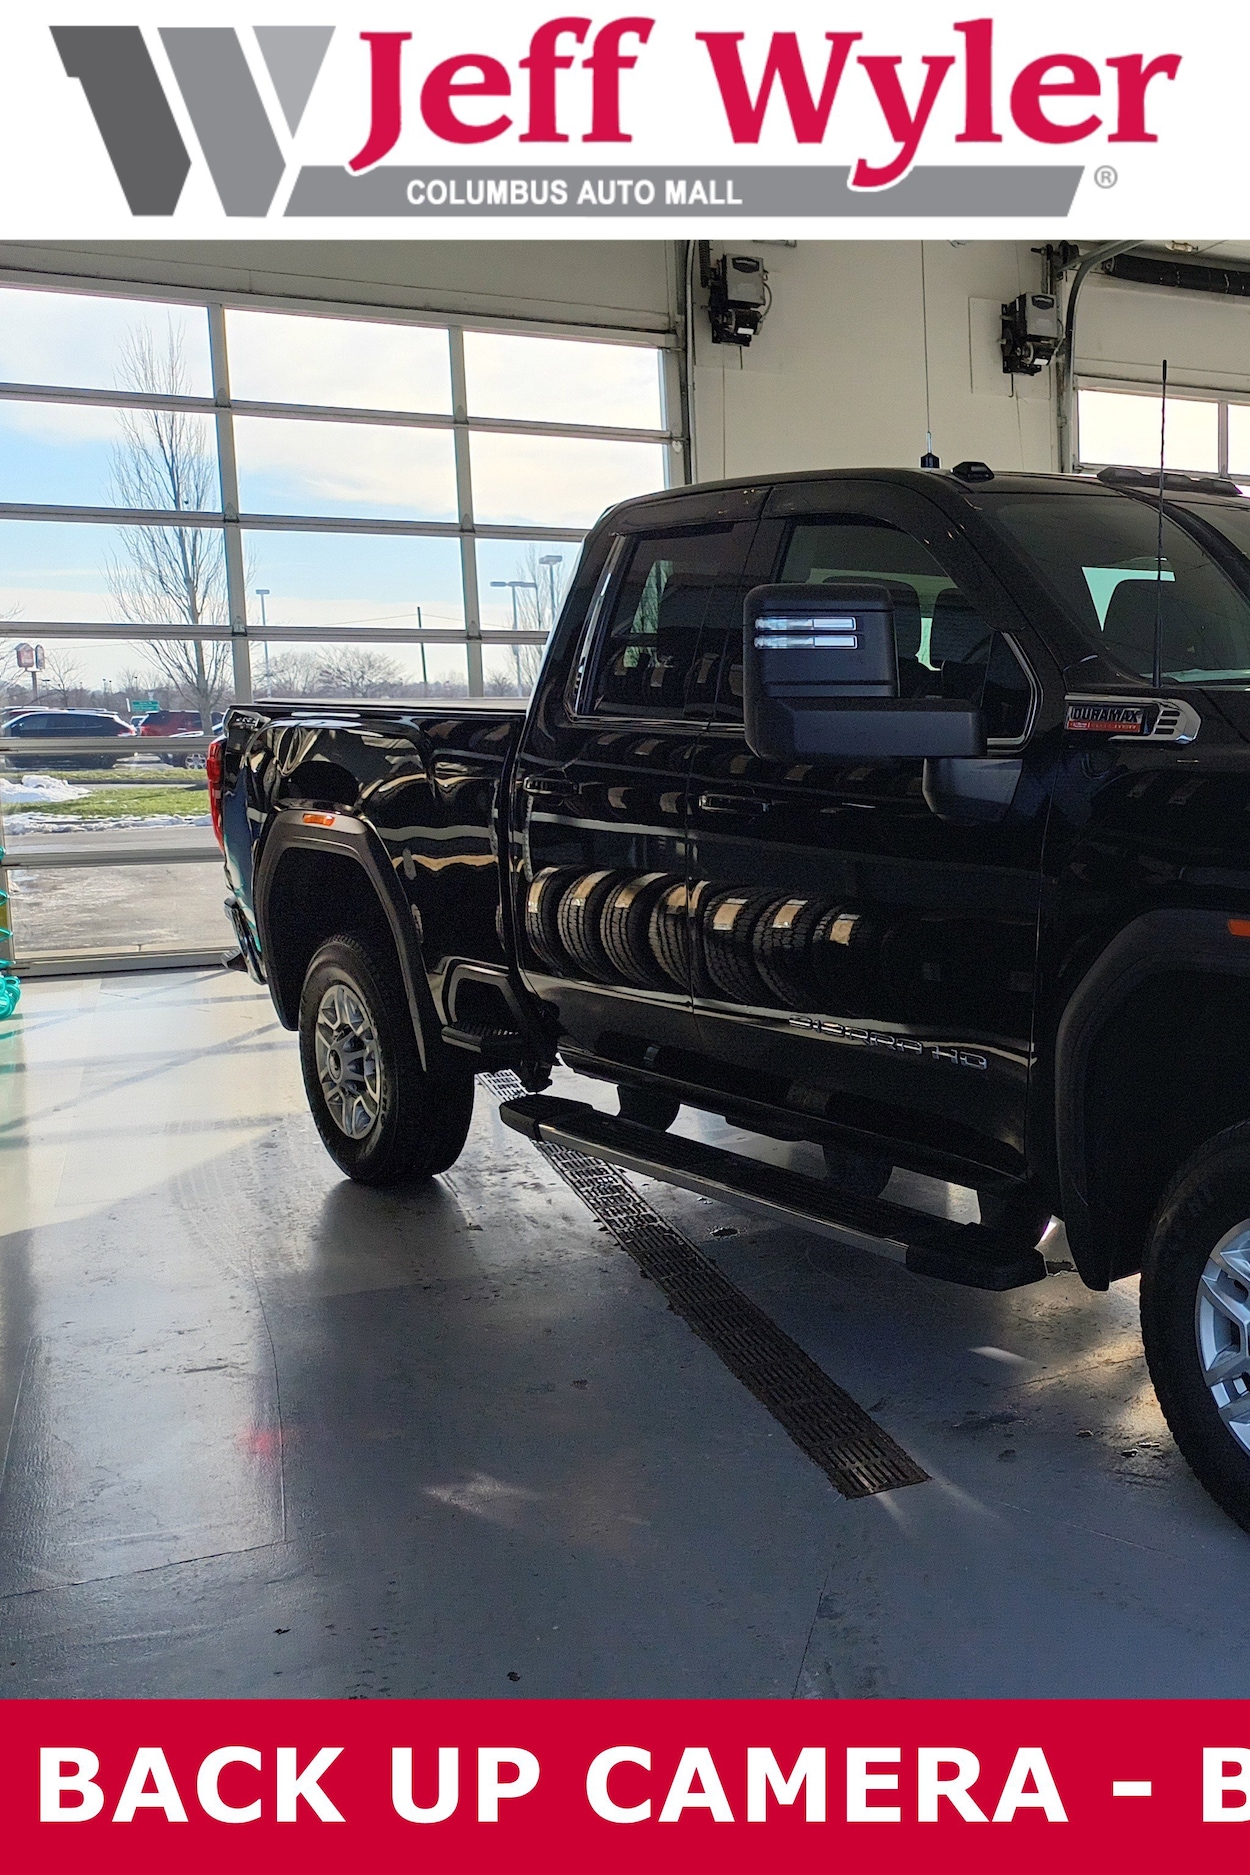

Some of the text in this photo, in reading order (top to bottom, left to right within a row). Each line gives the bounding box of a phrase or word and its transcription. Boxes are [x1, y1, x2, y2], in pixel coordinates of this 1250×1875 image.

[1071, 707, 1140, 723] DURAMAX
[788, 1014, 988, 1070] SIERRA HD
